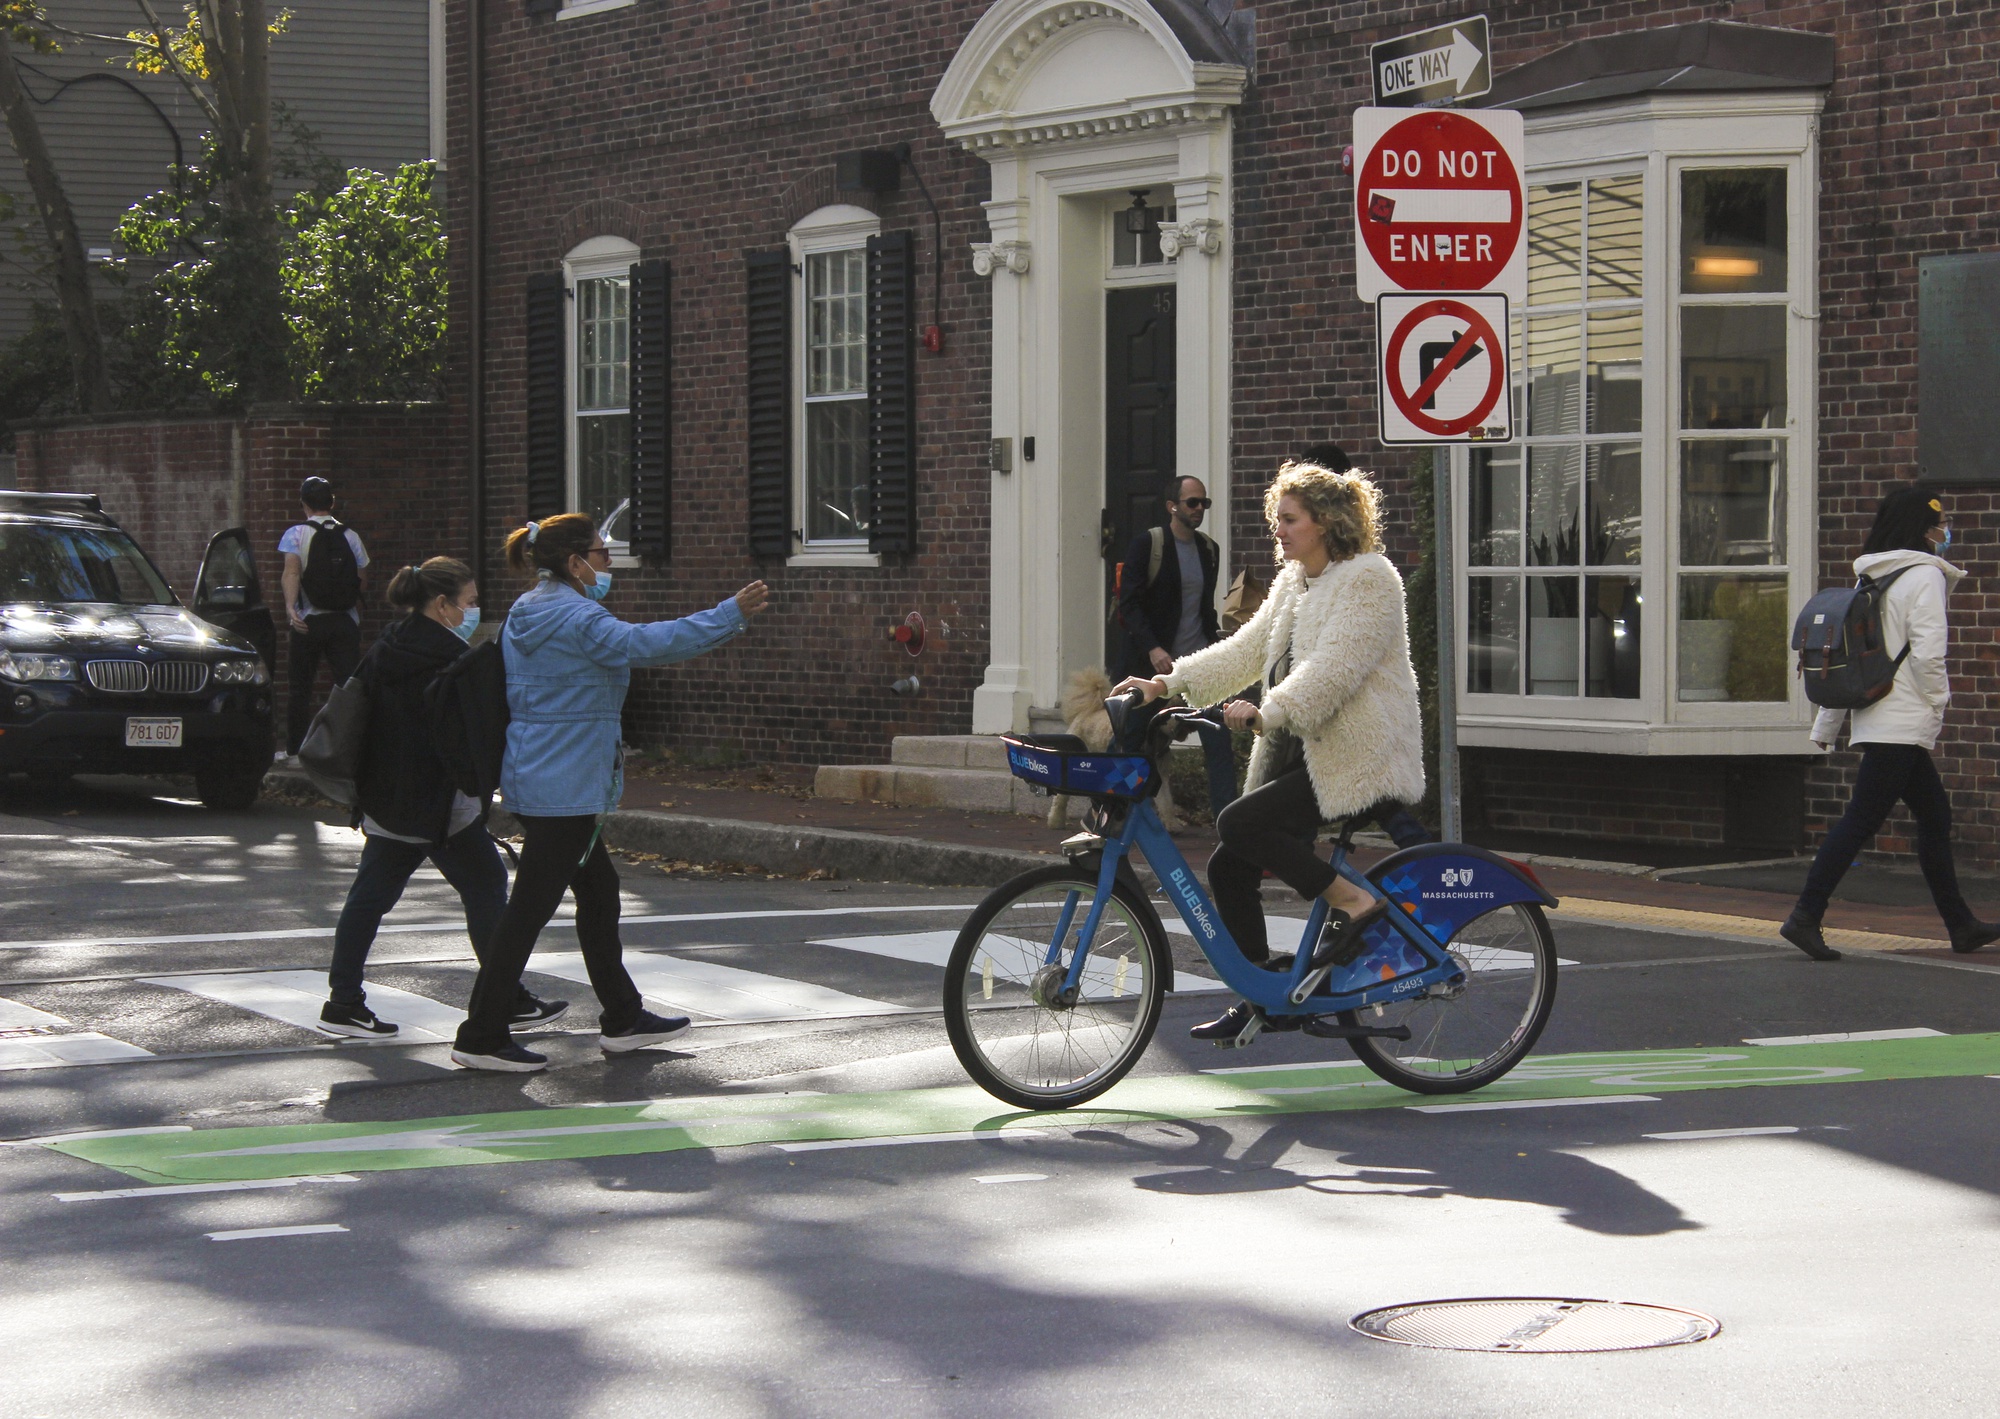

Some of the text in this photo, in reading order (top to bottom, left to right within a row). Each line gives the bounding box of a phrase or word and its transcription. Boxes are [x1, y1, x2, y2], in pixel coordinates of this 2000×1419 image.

[1384, 49, 1451, 91] ONE WAY
[1382, 149, 1497, 178] DO NOT
[1153, 292, 1171, 313] 45
[130, 725, 179, 740] 781 GD7
[1010, 752, 1049, 775] BLUEbikes
[1169, 867, 1217, 940] BLUEbikes
[1422, 891, 1495, 899] MASSACHUSETTS
[1392, 977, 1424, 994] 45493
